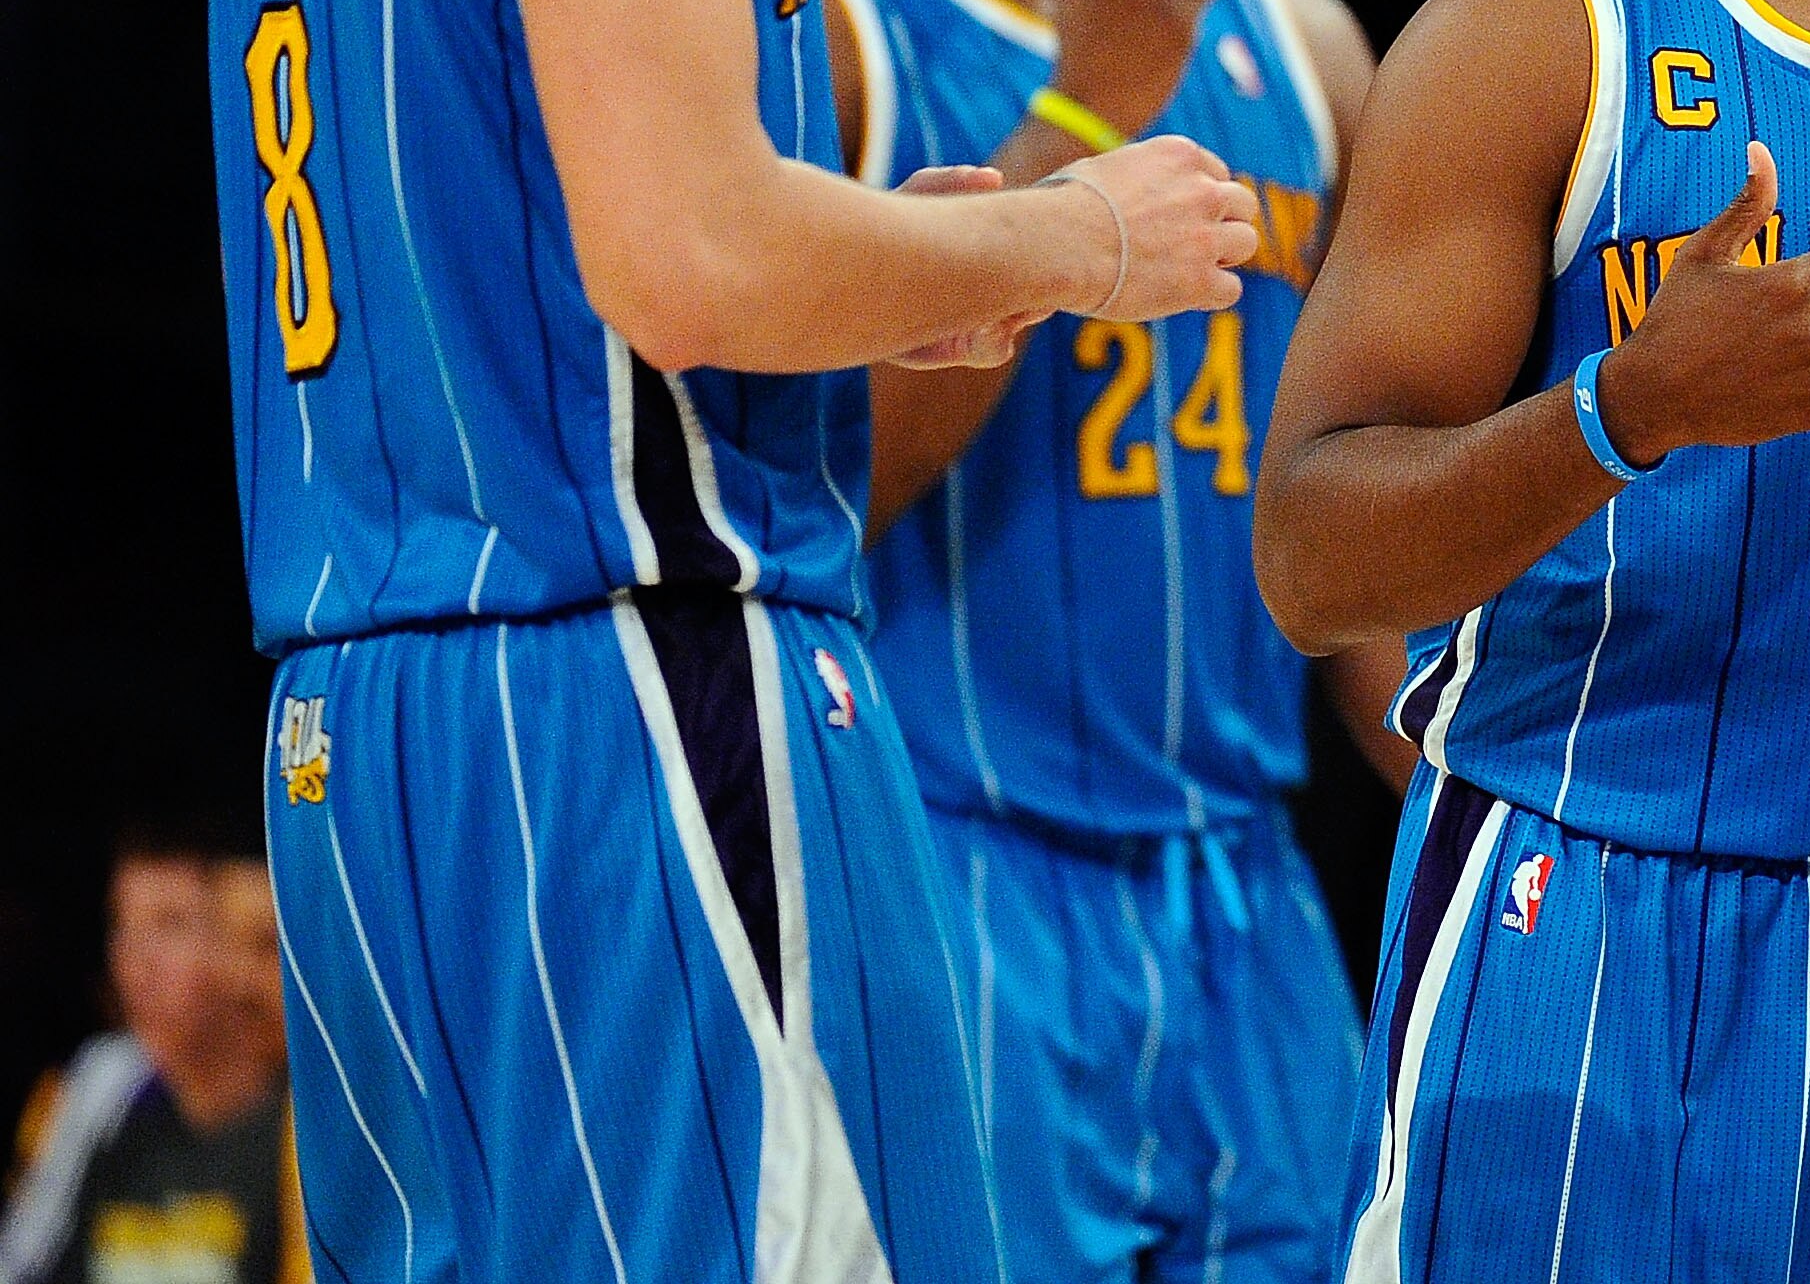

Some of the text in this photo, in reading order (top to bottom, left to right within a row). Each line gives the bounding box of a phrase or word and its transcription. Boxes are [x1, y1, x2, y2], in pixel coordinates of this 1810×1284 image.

[1648, 46, 1717, 131] C
[1072, 312, 1251, 497] 24
[1501, 911, 1525, 930] NBA
